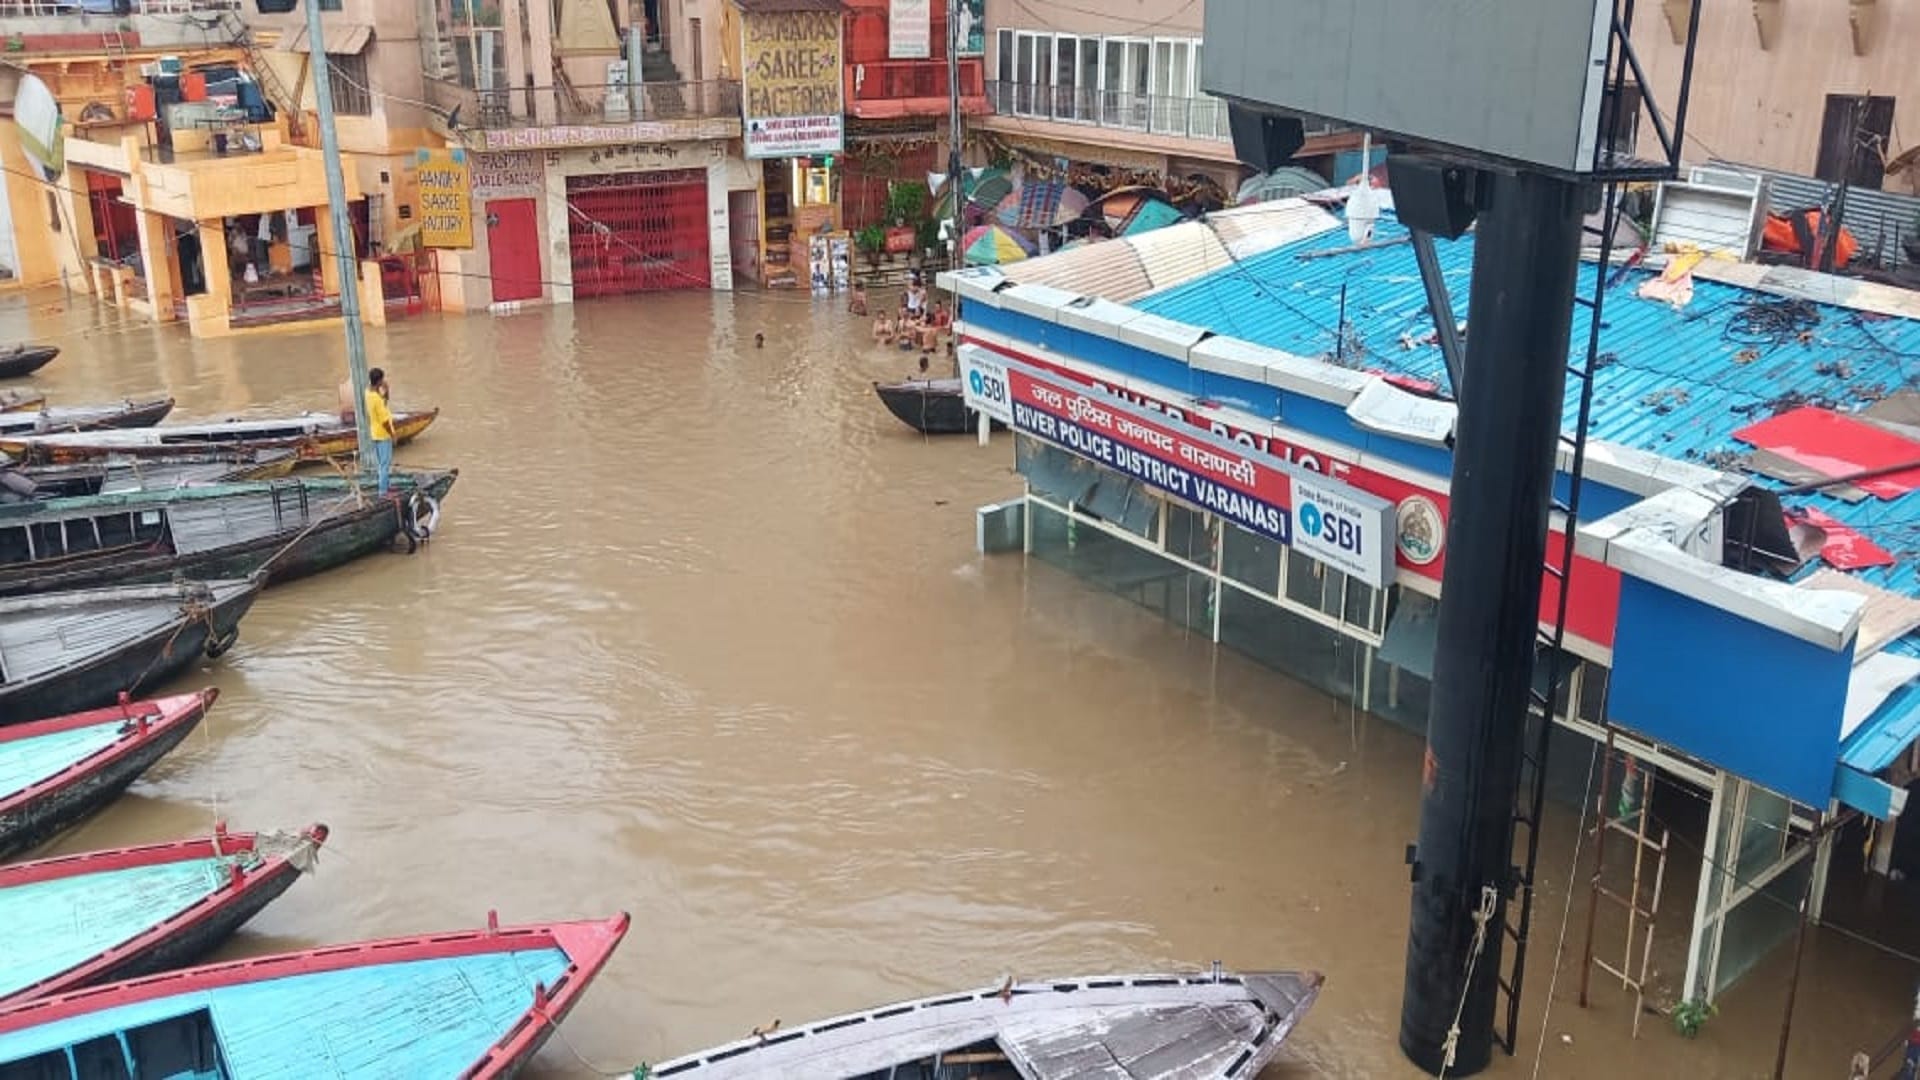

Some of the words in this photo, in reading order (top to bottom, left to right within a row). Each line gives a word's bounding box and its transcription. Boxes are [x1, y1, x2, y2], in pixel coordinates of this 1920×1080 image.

[760, 49, 821, 80] SAREE
[750, 84, 837, 116] FACTORY
[420, 169, 460, 188] PANDEY
[472, 174, 502, 188] SAREE
[422, 193, 460, 210] SAREE
[423, 215, 463, 231] FACTORY
[983, 374, 1006, 405] SBI
[1031, 384, 1062, 408] जल
[1067, 393, 1113, 428] पुलिस
[1115, 416, 1174, 453] जनपद
[1178, 440, 1256, 486] वाराणसी
[1016, 401, 1057, 438] RIVER
[1059, 421, 1112, 460] POLICE
[1116, 444, 1190, 494] DISTRICT
[1194, 477, 1286, 537] VARANASI
[1316, 493, 1333, 507] Bank
[1323, 512, 1361, 556] SBI
